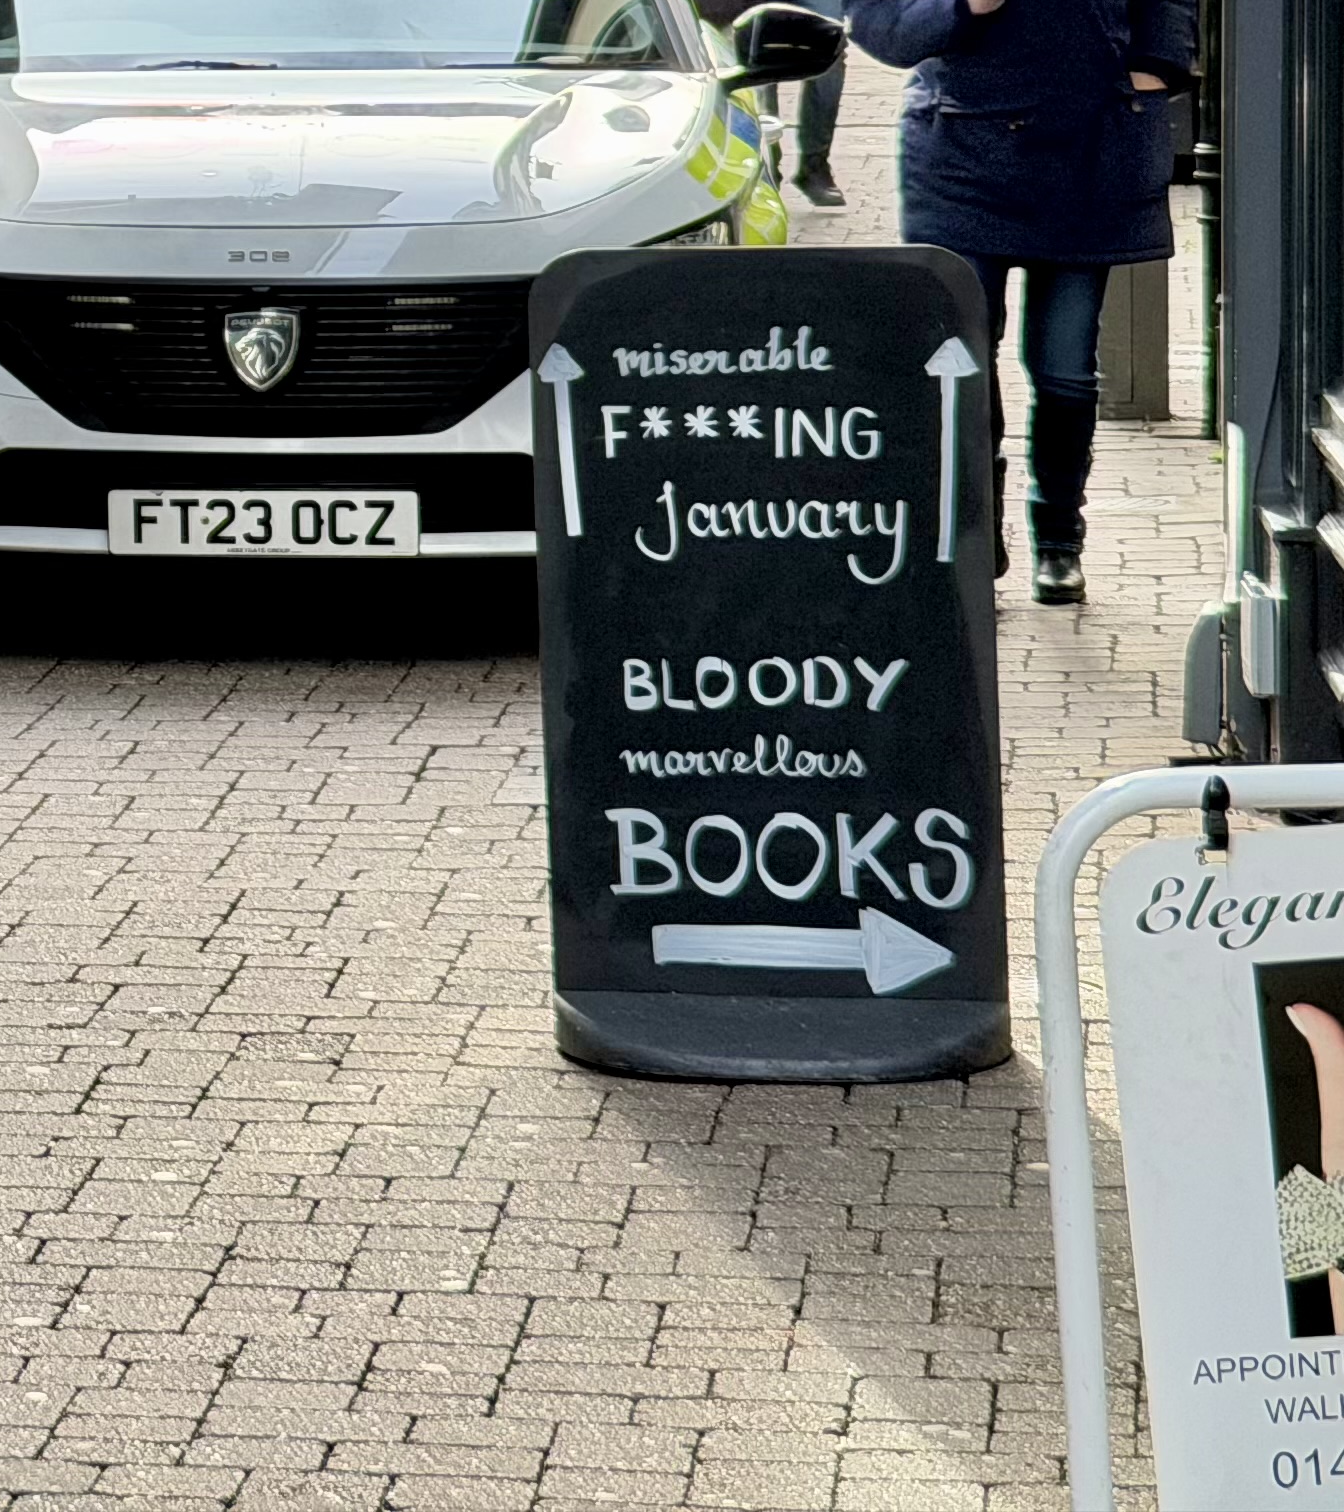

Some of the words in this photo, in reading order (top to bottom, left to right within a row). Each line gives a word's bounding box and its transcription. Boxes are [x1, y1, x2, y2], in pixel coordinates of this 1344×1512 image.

[228, 251, 289, 262] 308
[613, 326, 835, 377] miserable
[132, 497, 273, 547] FT23
[291, 498, 396, 547] OCZ
[623, 656, 910, 712] BLOODY
[619, 733, 867, 778] marvellous
[604, 807, 976, 910] BOOKS
[1193, 1349, 1342, 1385] APPOINT
